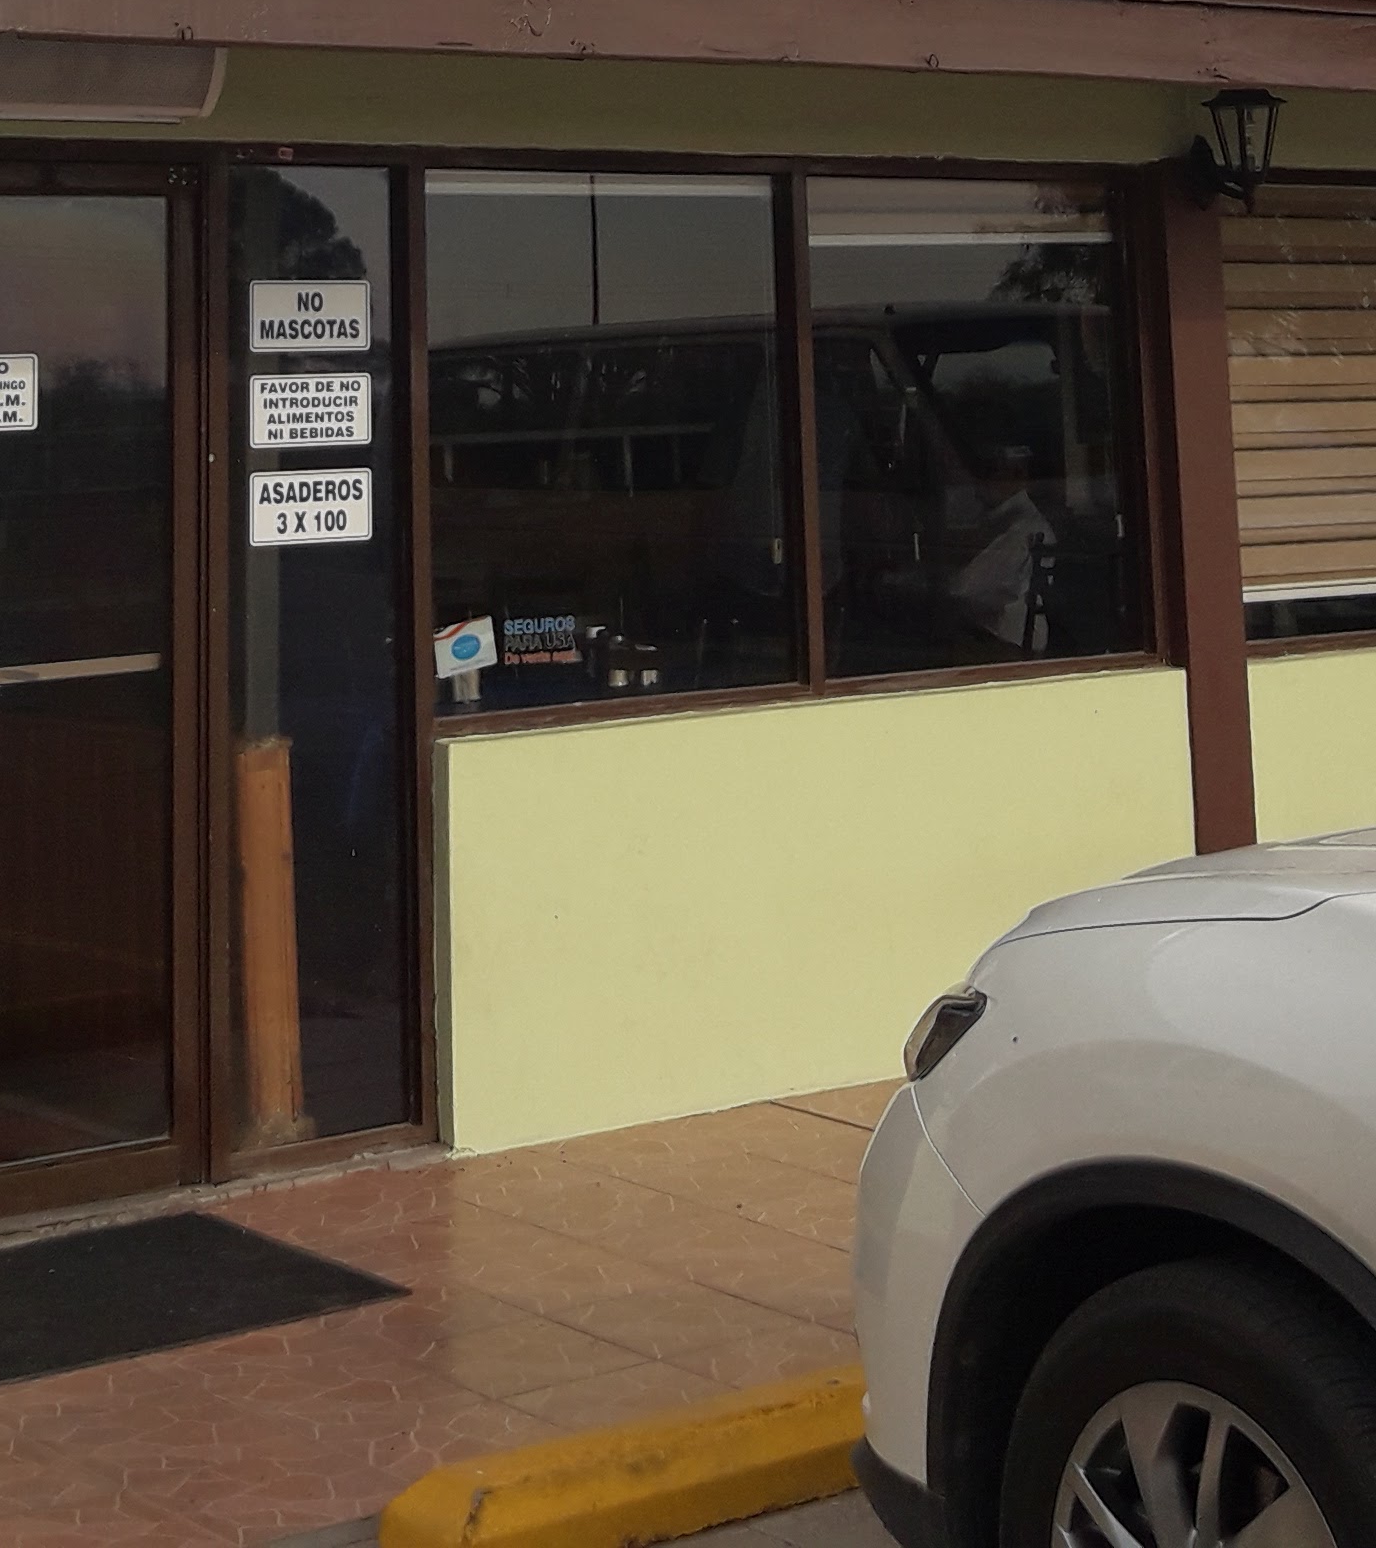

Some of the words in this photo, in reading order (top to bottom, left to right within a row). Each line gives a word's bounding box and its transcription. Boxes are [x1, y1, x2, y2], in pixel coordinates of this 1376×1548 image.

[297, 292, 324, 312] NO
[260, 319, 360, 340] MASCOTAS
[260, 382, 310, 394] FAVOR
[315, 381, 334, 393] DE
[340, 380, 361, 392] NO
[263, 395, 359, 410] INTRODUCIR
[267, 411, 355, 425] ALIMENTOS
[268, 428, 284, 440] NI
[289, 426, 355, 439] BEBIDAS
[258, 478, 364, 505] ASADEROS
[276, 512, 288, 534] 3
[294, 511, 307, 533] X
[314, 508, 347, 532] 100
[503, 615, 576, 636] SEGUROS
